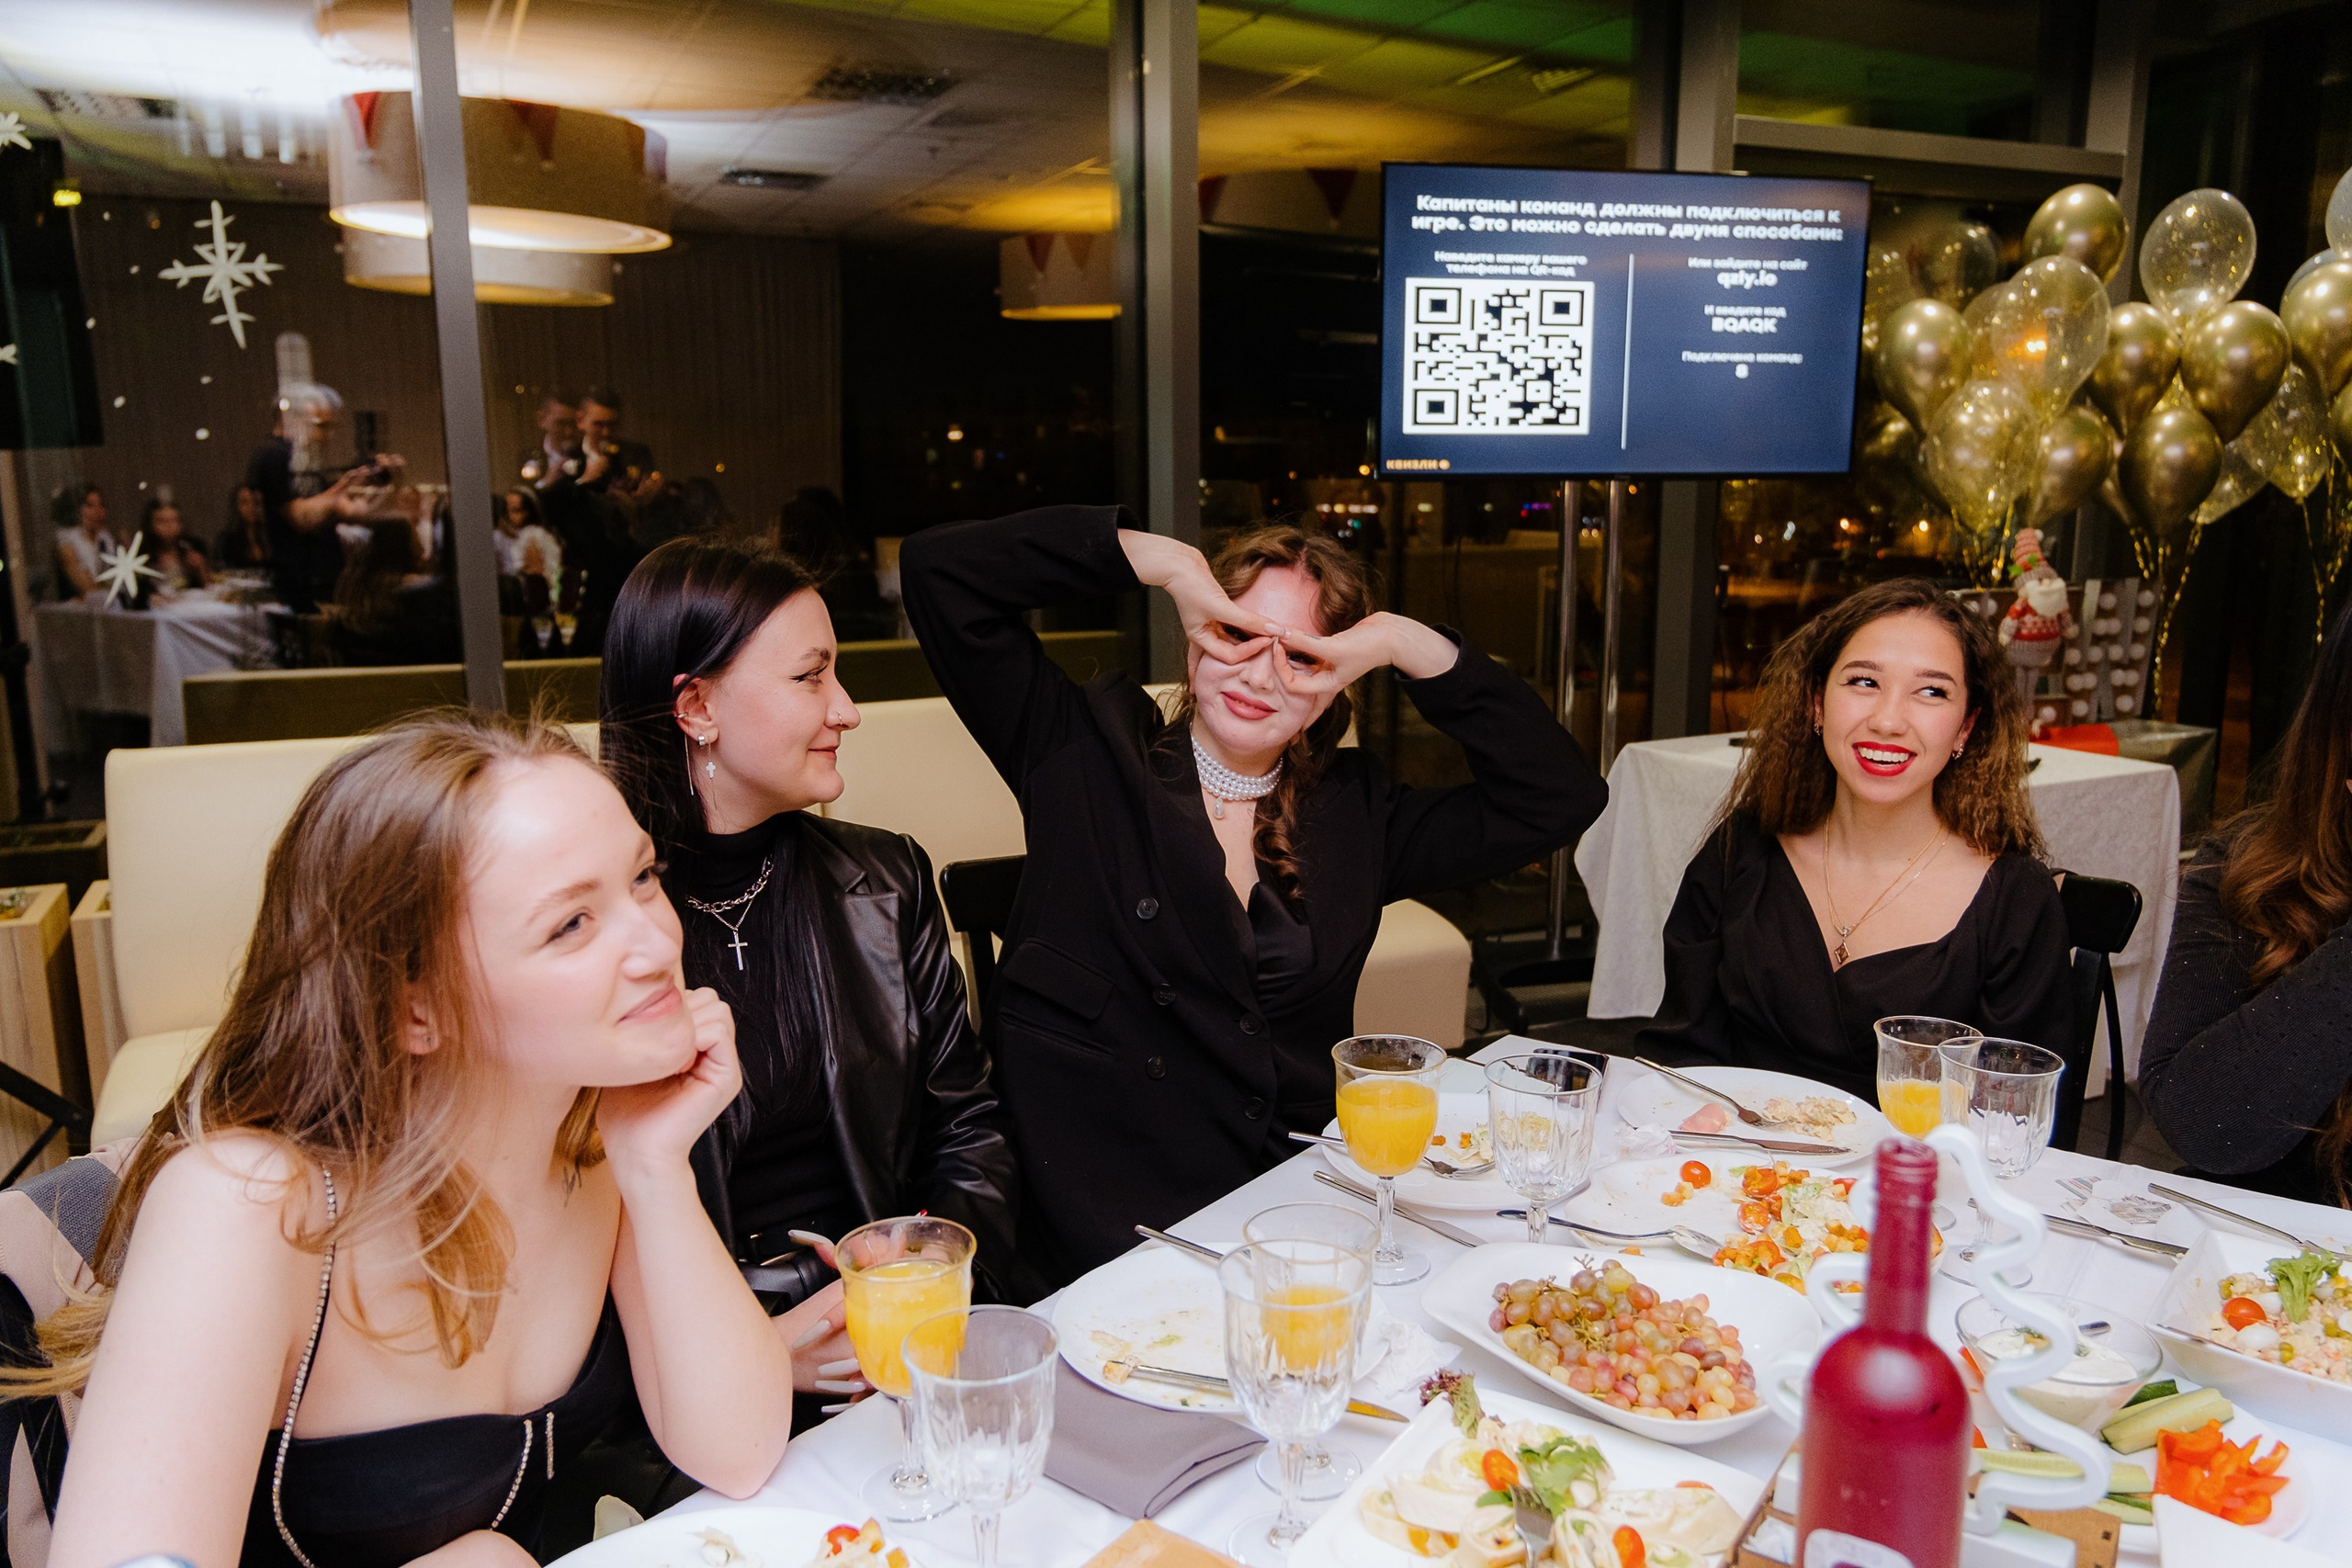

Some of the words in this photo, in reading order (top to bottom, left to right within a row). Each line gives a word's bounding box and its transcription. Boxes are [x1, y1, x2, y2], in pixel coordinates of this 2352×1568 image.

[1417, 195, 1517, 213] Капитаны
[1521, 200, 1597, 218] команд
[1599, 202, 1683, 219] должны
[1686, 206, 1825, 221] подключиться
[1827, 209, 1841, 223] к
[1411, 215, 1466, 233] игре.
[1469, 215, 1509, 231] Это
[1511, 219, 1581, 233] можно
[1584, 220, 1666, 236] сделать
[1668, 223, 1730, 240] двумя
[1732, 223, 1844, 241] способами:
